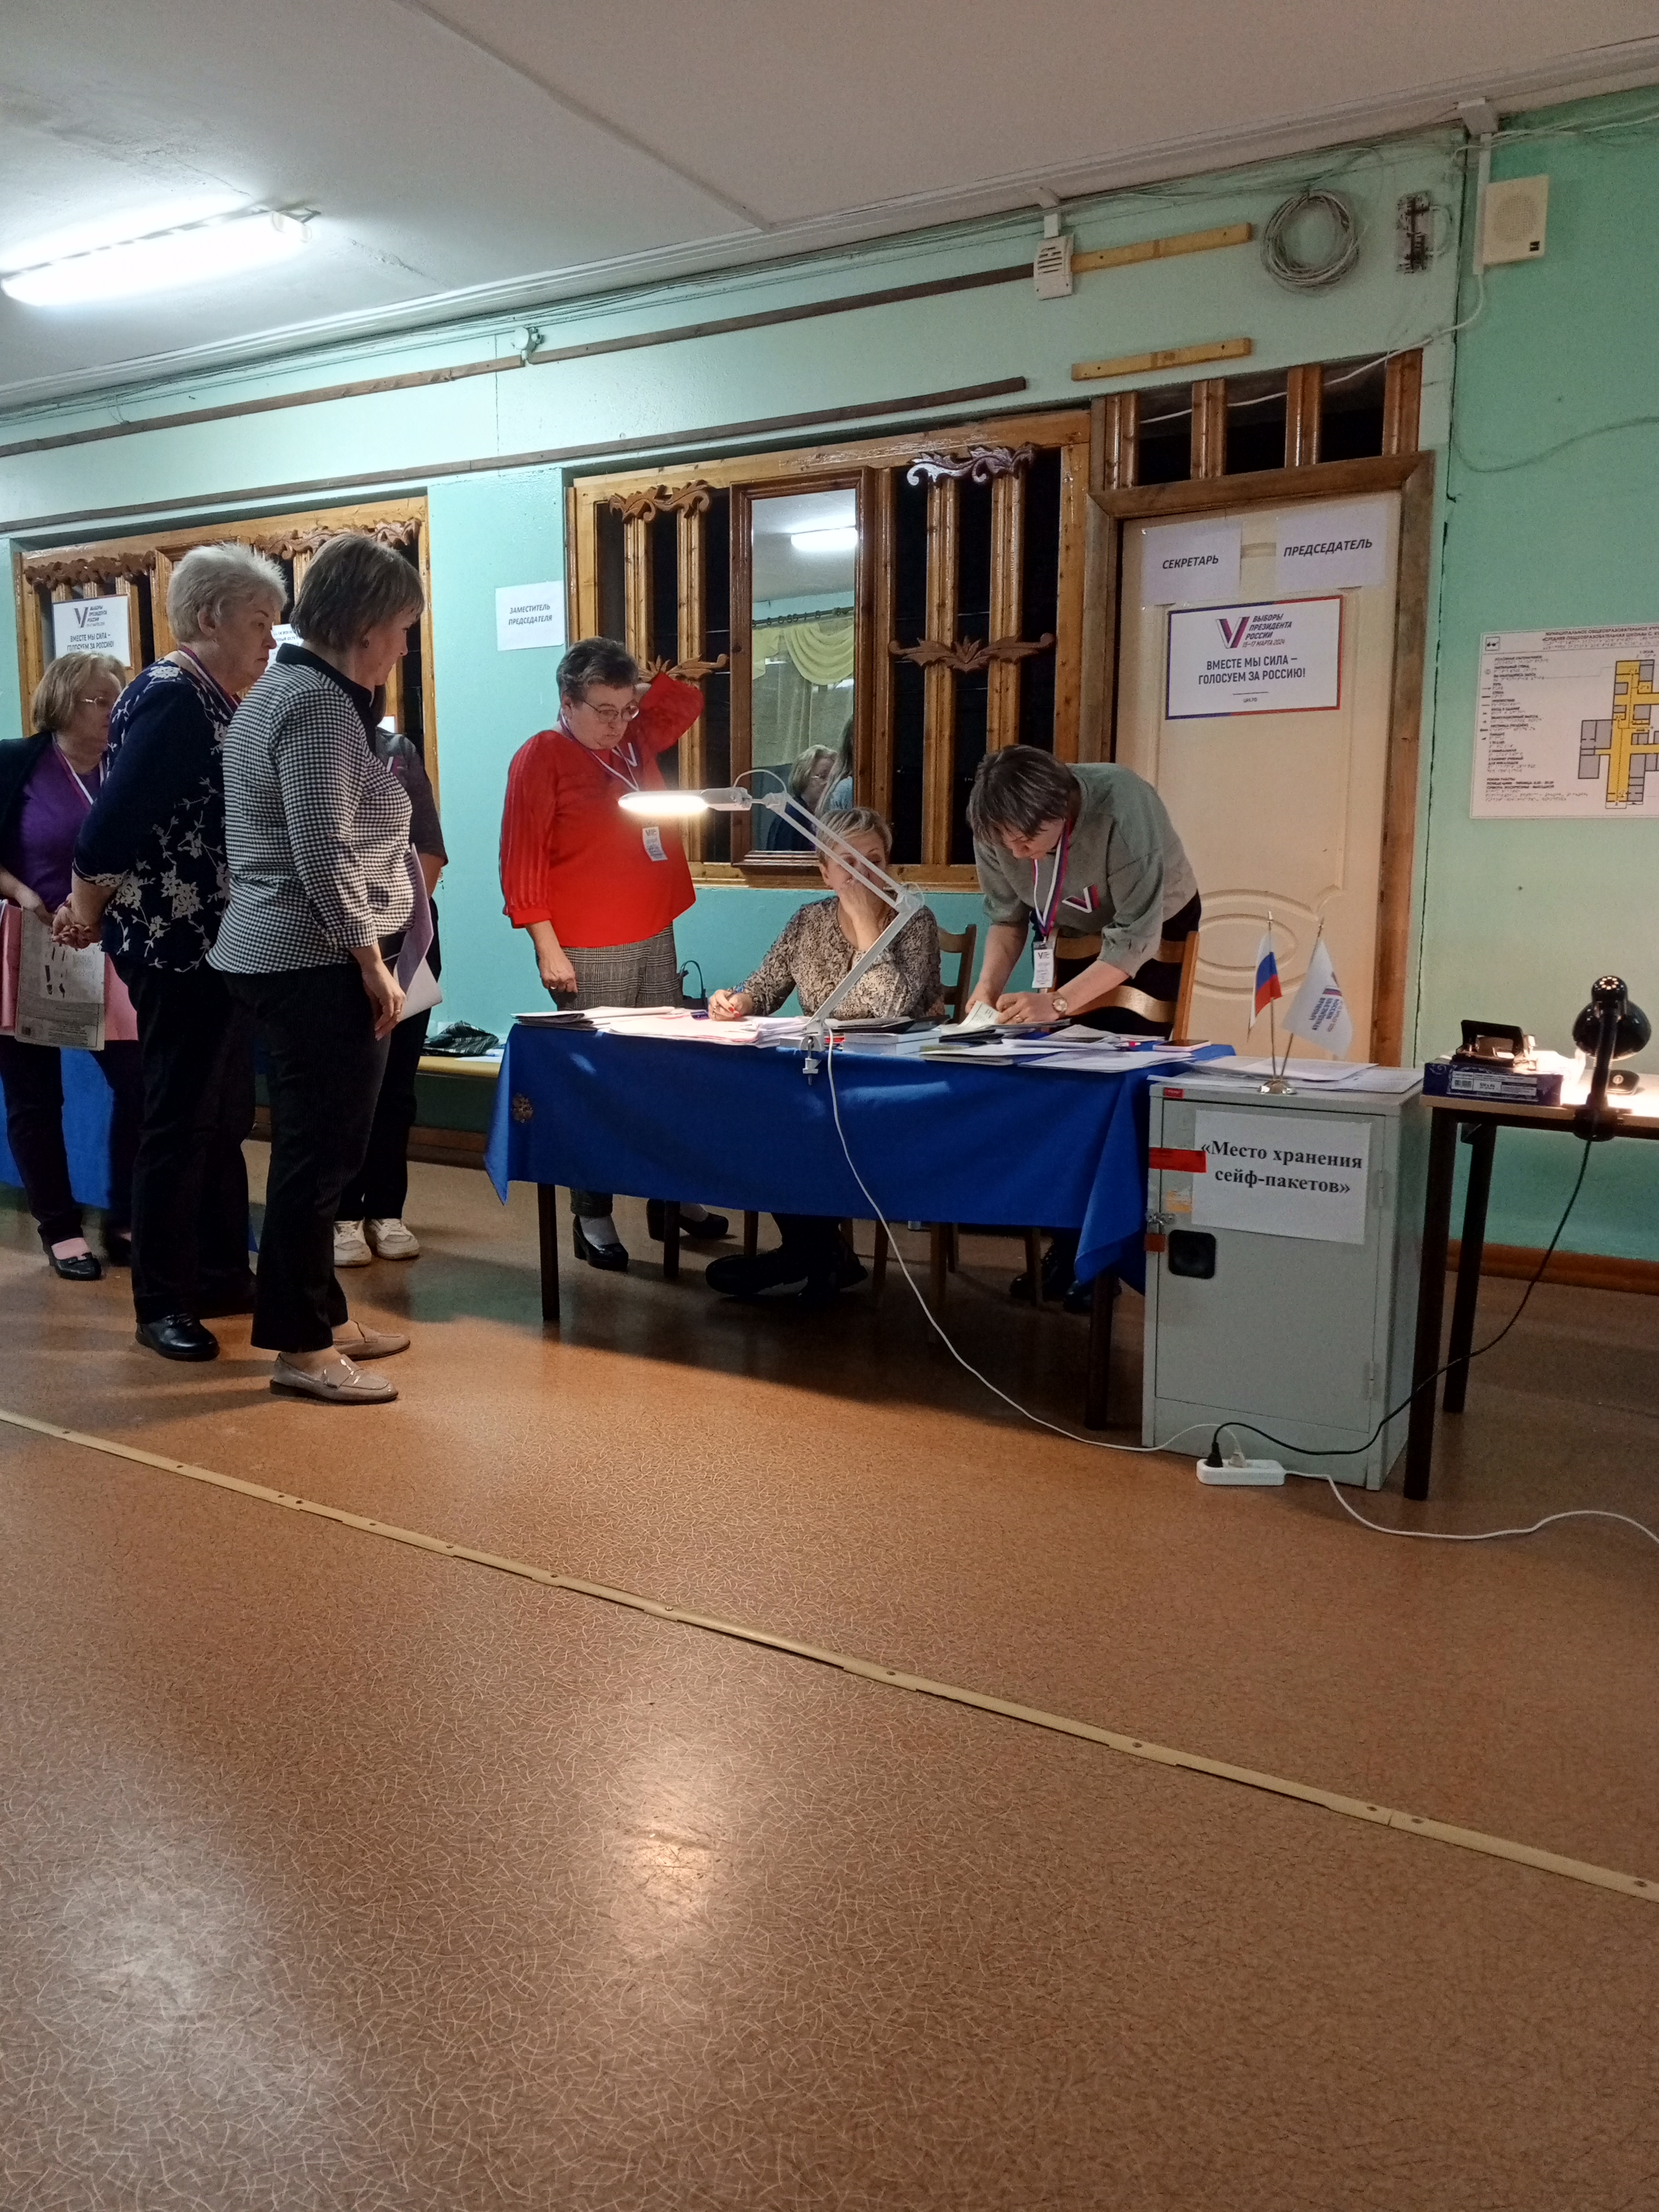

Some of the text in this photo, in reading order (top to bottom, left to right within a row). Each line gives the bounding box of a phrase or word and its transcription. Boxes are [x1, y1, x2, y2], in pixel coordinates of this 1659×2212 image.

[1283, 538, 1372, 557] ПРЕДСЕДАТЕЛЬ
[1162, 555, 1219, 569] СЕКРЕТАРЬ
[509, 604, 550, 614] ЗАМЕСТИТЕЛЬ
[508, 615, 552, 625] ПРЕДСЕДАТЕЛЯ
[1252, 613, 1284, 623] ВЫБОРЫ
[1249, 621, 1293, 631] ПРЕЗИДЕНТА
[70, 634, 87, 642] ВМЕСТЕ
[1245, 631, 1274, 640] РОССИИ
[1207, 658, 1242, 670] ВМЕСТЕ
[1244, 657, 1261, 667] МЫ
[1263, 655, 1289, 666] СИЛА
[1198, 668, 1306, 685] ГОЛОСУЕМ ЗА РОССИЮ!
[1201, 1140, 1362, 1169] «Место хранения
[1214, 1169, 1351, 1194] сейф-пакетов»
